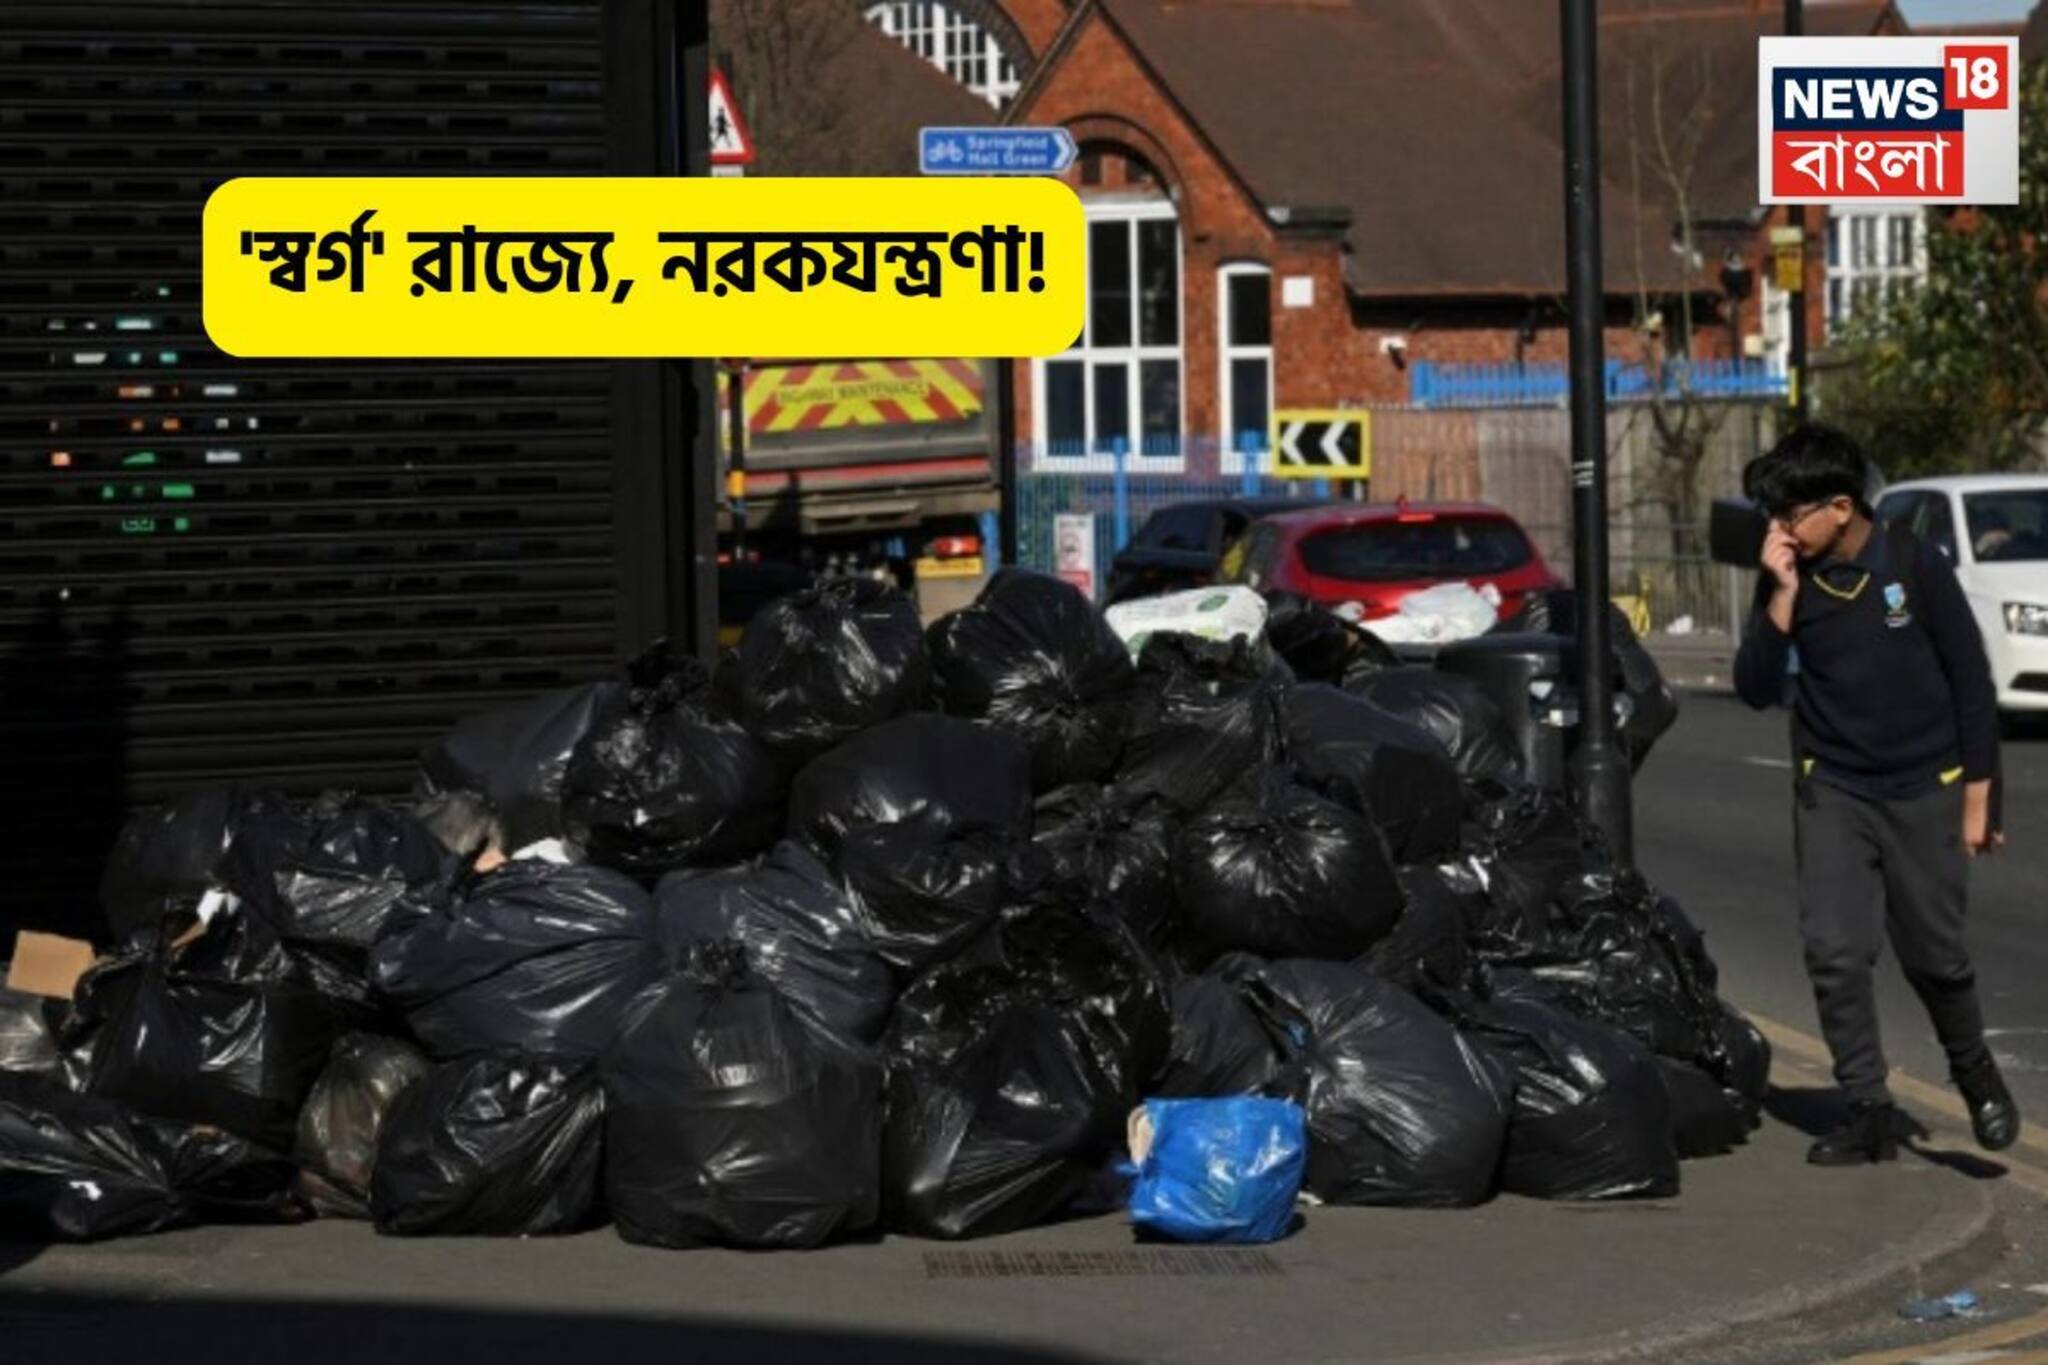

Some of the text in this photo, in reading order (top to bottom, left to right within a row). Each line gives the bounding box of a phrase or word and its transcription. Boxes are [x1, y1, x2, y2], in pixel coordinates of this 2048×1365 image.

[966, 135, 1048, 151] Springfield
[968, 151, 1047, 165] Hall Green
